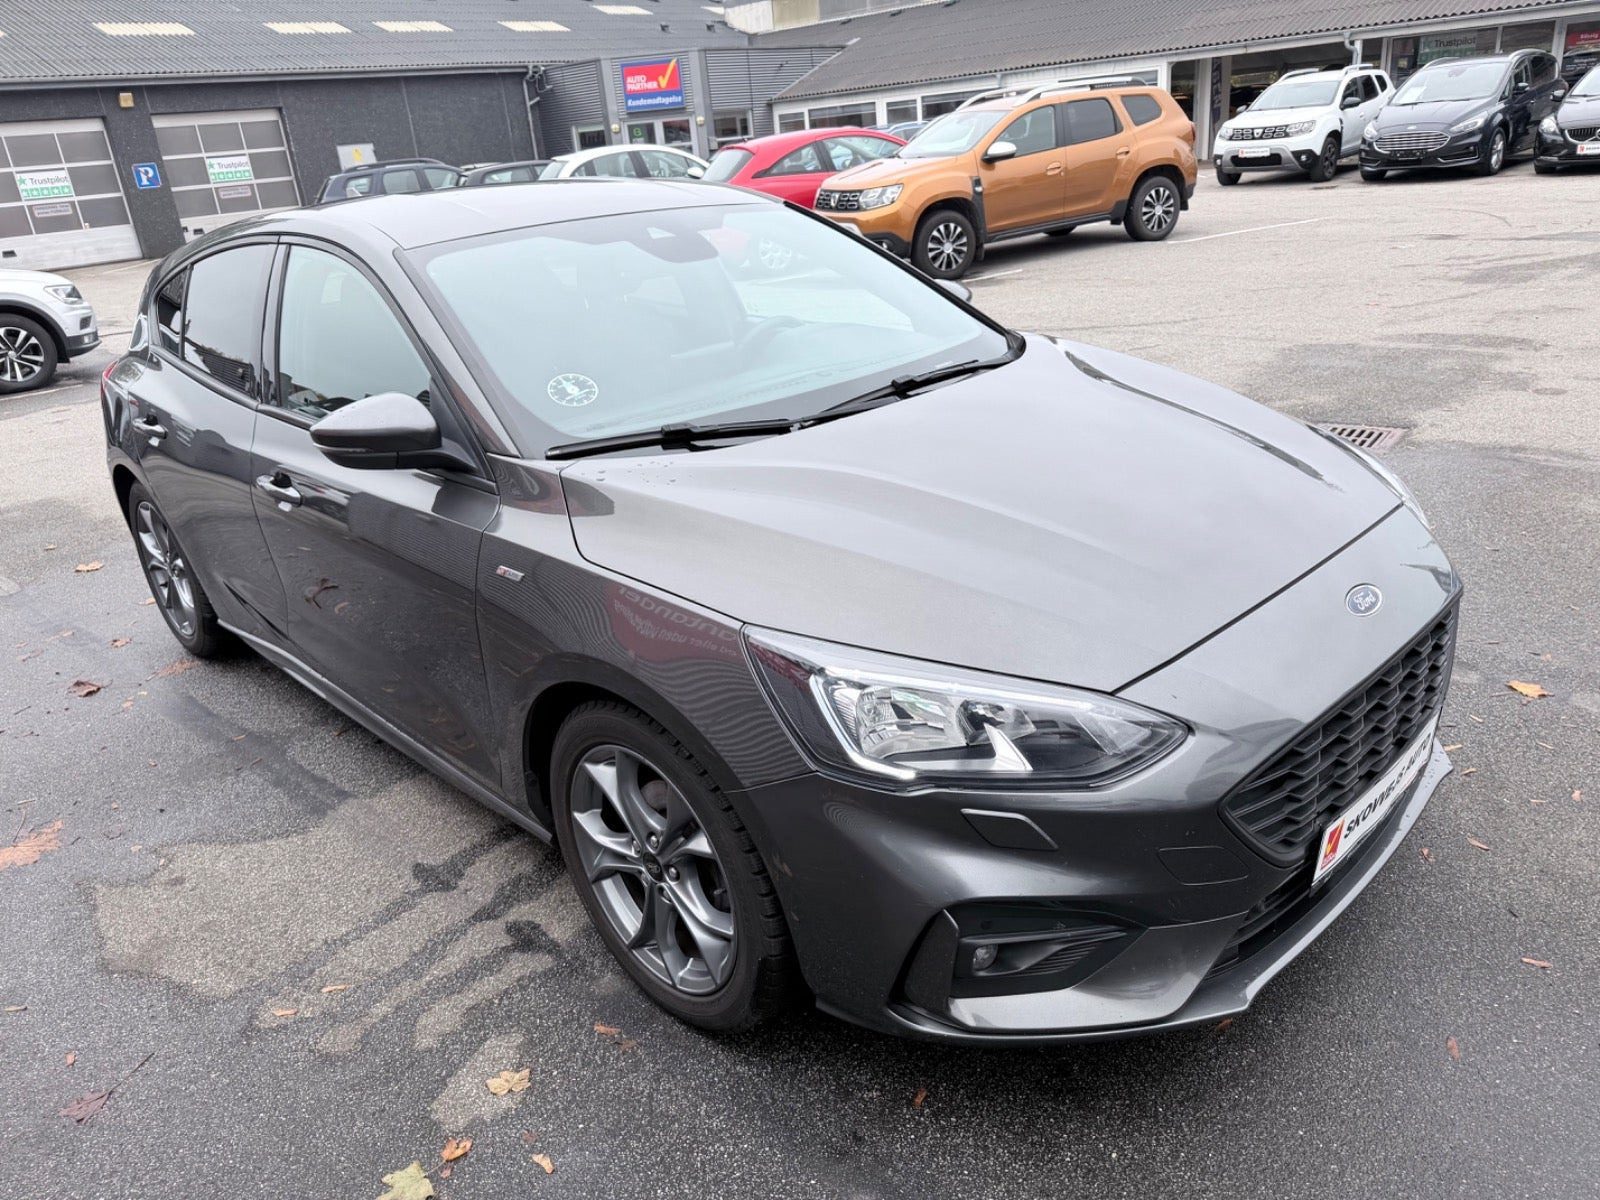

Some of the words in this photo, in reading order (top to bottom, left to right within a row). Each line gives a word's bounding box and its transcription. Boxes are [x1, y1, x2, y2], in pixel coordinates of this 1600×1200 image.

[1434, 36, 1477, 47] Trustpilot
[626, 75, 646, 83] AUTO
[627, 81, 658, 91] PARTNER
[216, 160, 250, 169] Trustpilot
[29, 175, 69, 185] Trustpilot
[138, 167, 154, 185] P
